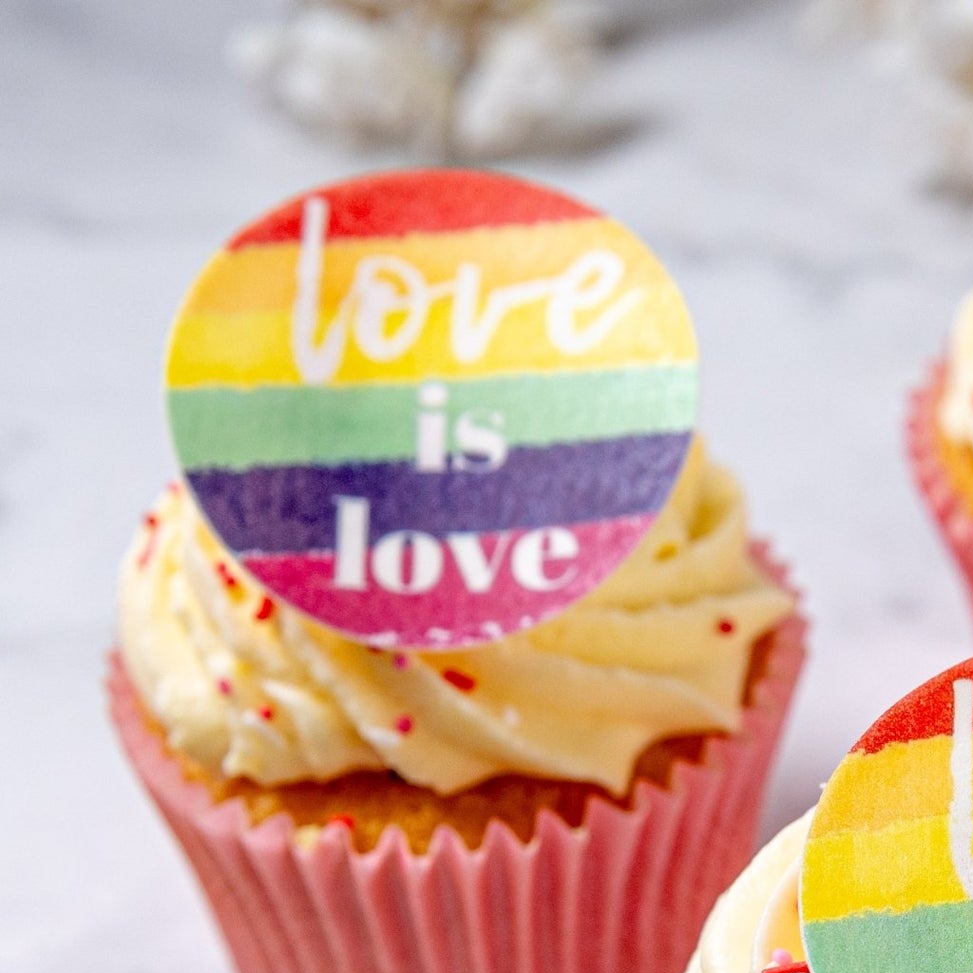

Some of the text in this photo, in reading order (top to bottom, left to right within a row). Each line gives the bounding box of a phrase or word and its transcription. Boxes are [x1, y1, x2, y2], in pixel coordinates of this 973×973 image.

[290, 195, 645, 384] love
[415, 381, 509, 472] is
[332, 495, 580, 594] love
